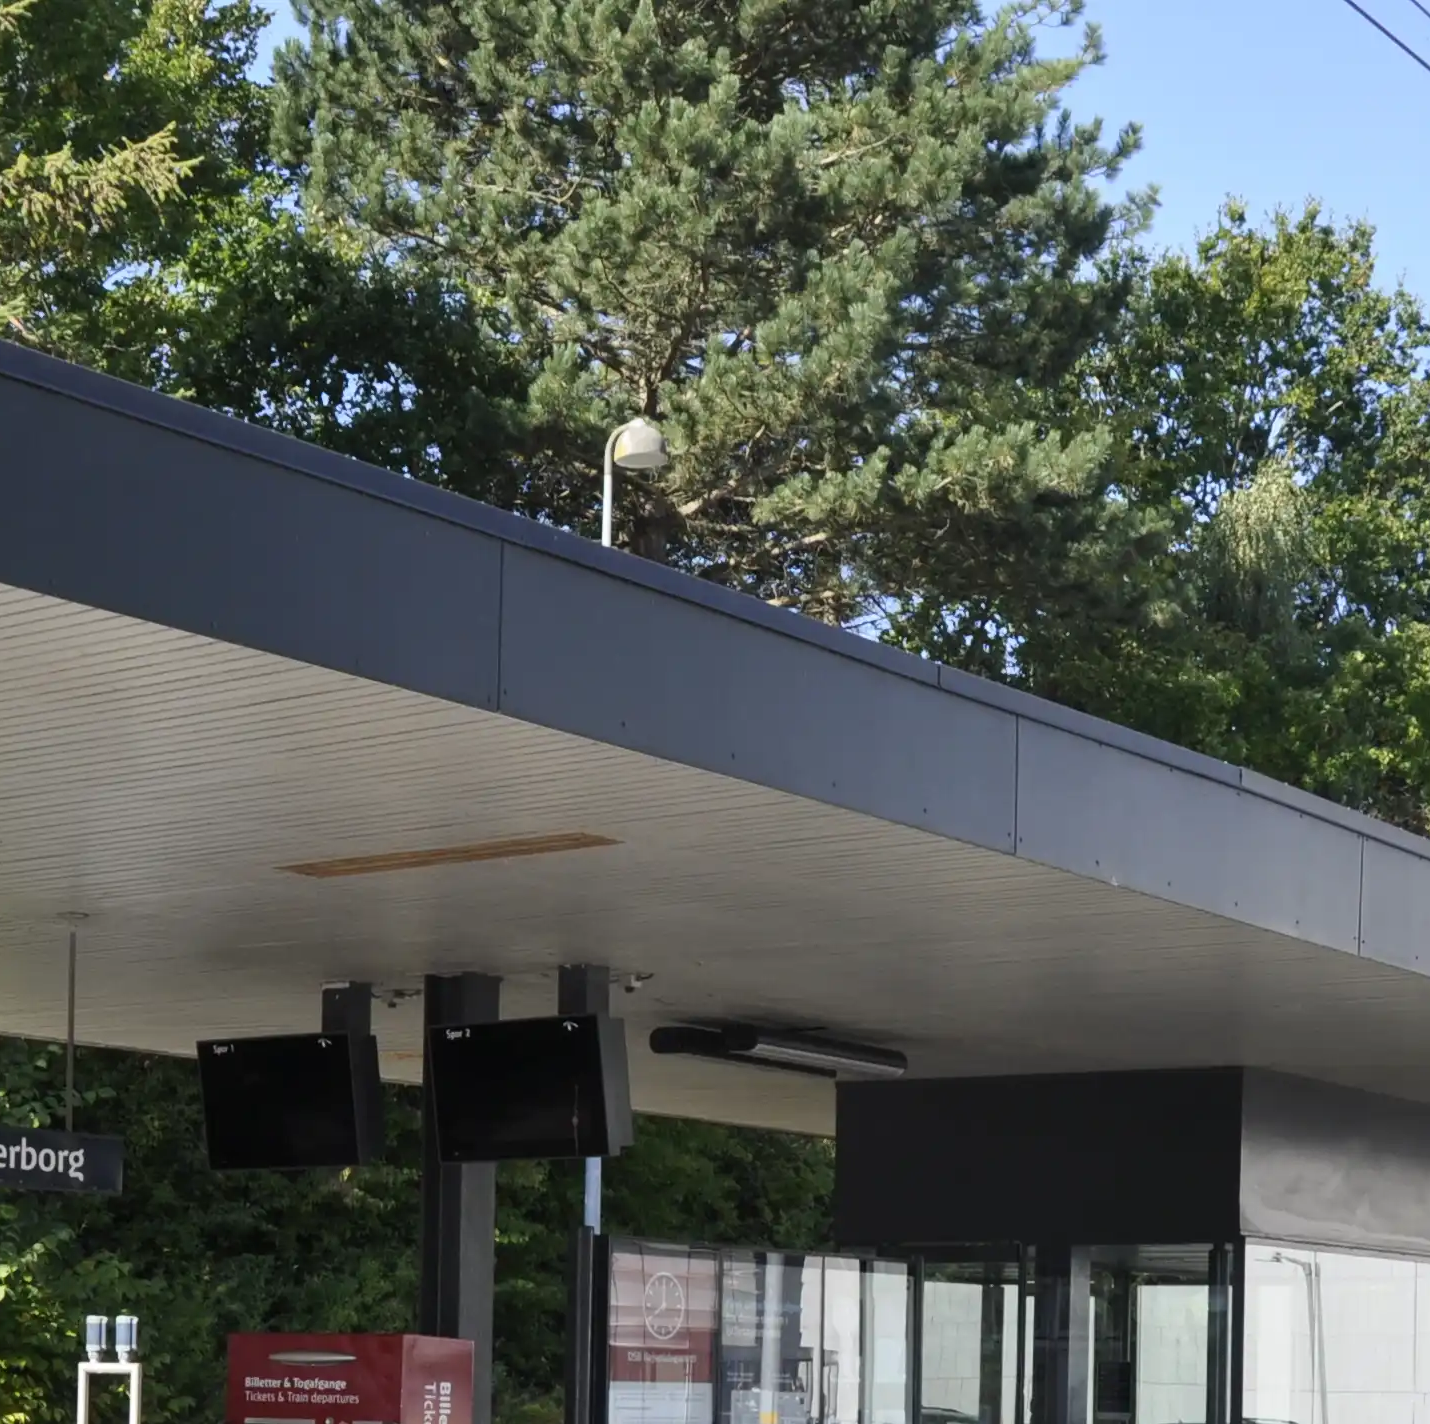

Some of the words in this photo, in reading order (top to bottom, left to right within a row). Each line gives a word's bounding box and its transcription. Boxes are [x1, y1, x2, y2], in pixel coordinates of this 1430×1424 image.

[244, 1376, 280, 1388] Billetter
[283, 1377, 291, 1388] &
[293, 1377, 347, 1391] Togafgange
[244, 1390, 276, 1402] Tickets
[277, 1391, 285, 1402] &
[287, 1391, 308, 1402] Train
[310, 1392, 360, 1405] departures
